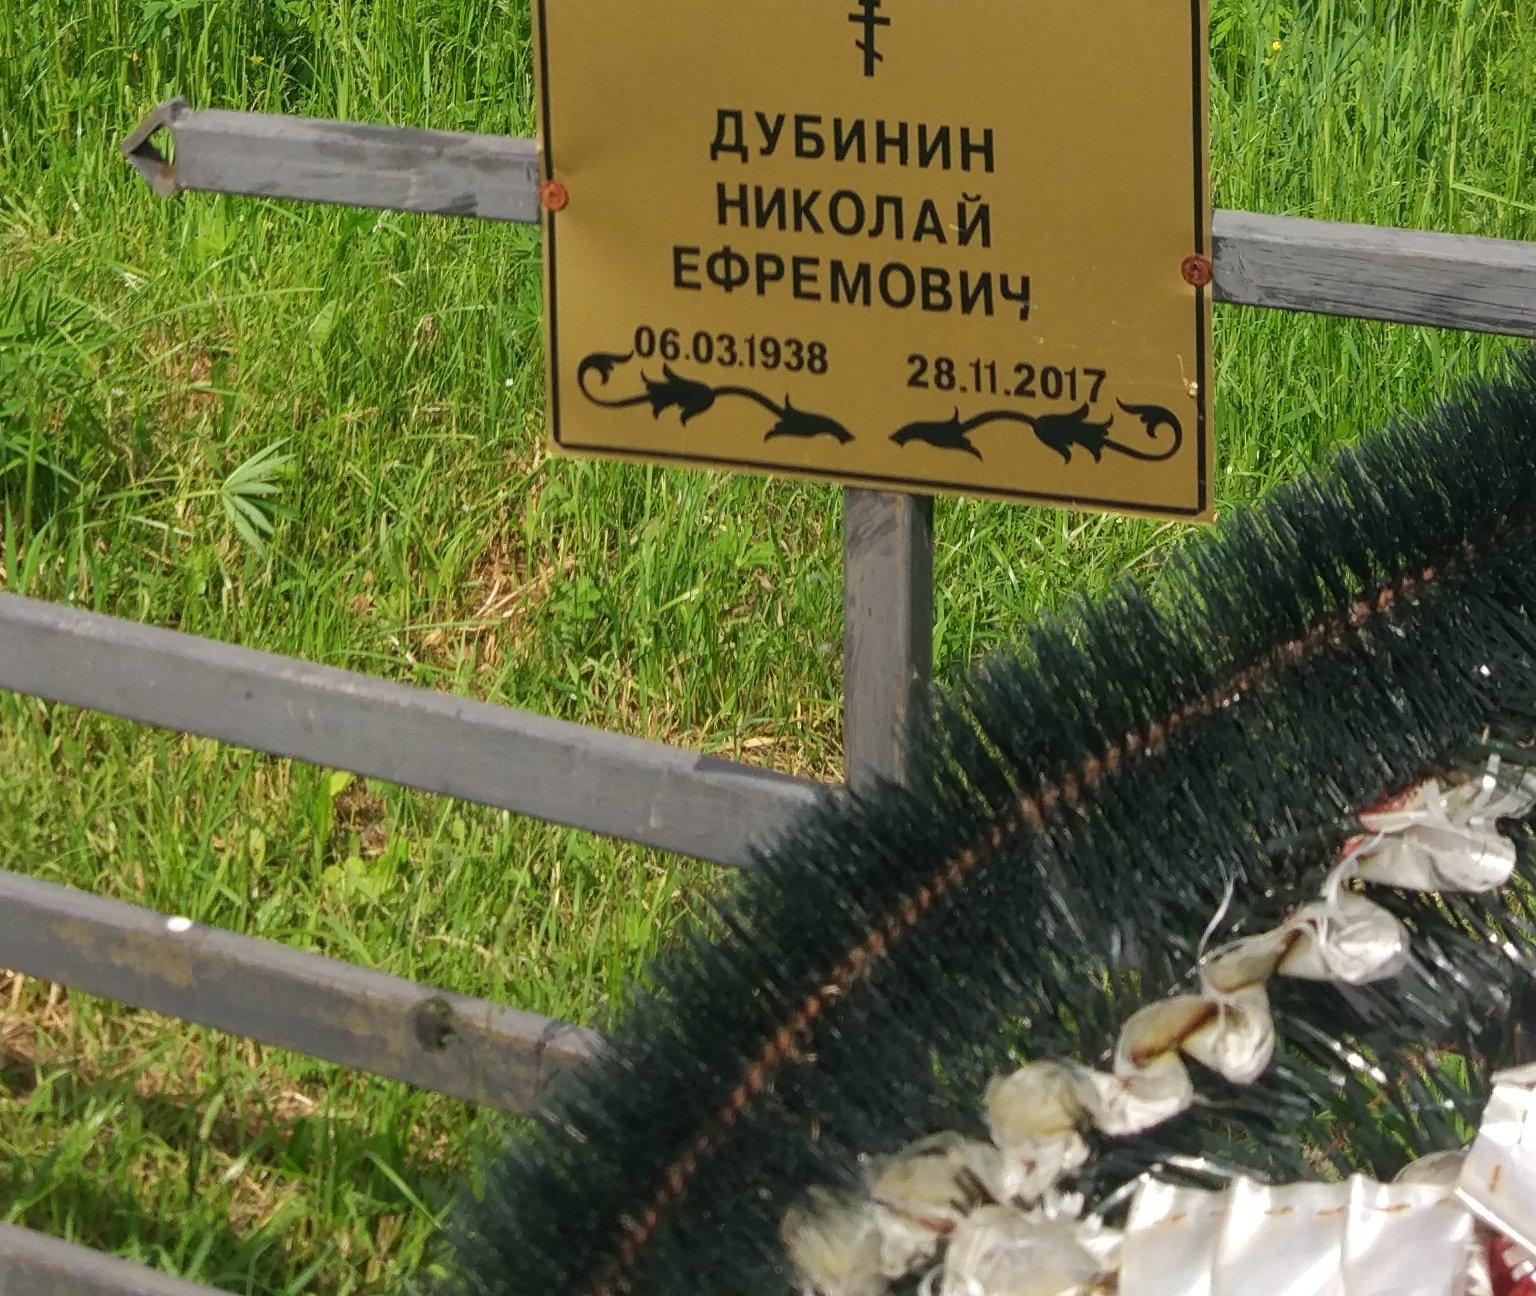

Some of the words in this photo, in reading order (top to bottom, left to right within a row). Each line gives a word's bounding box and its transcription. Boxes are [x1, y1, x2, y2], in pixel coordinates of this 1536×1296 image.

[709, 108, 995, 174] ДУБИНИН
[715, 181, 992, 249] НИКОЛАЙ
[672, 244, 1031, 322] ЕФРЕМОВИЧ
[633, 325, 830, 376] 06.03.1938
[906, 353, 1108, 404] 28.11.2017
